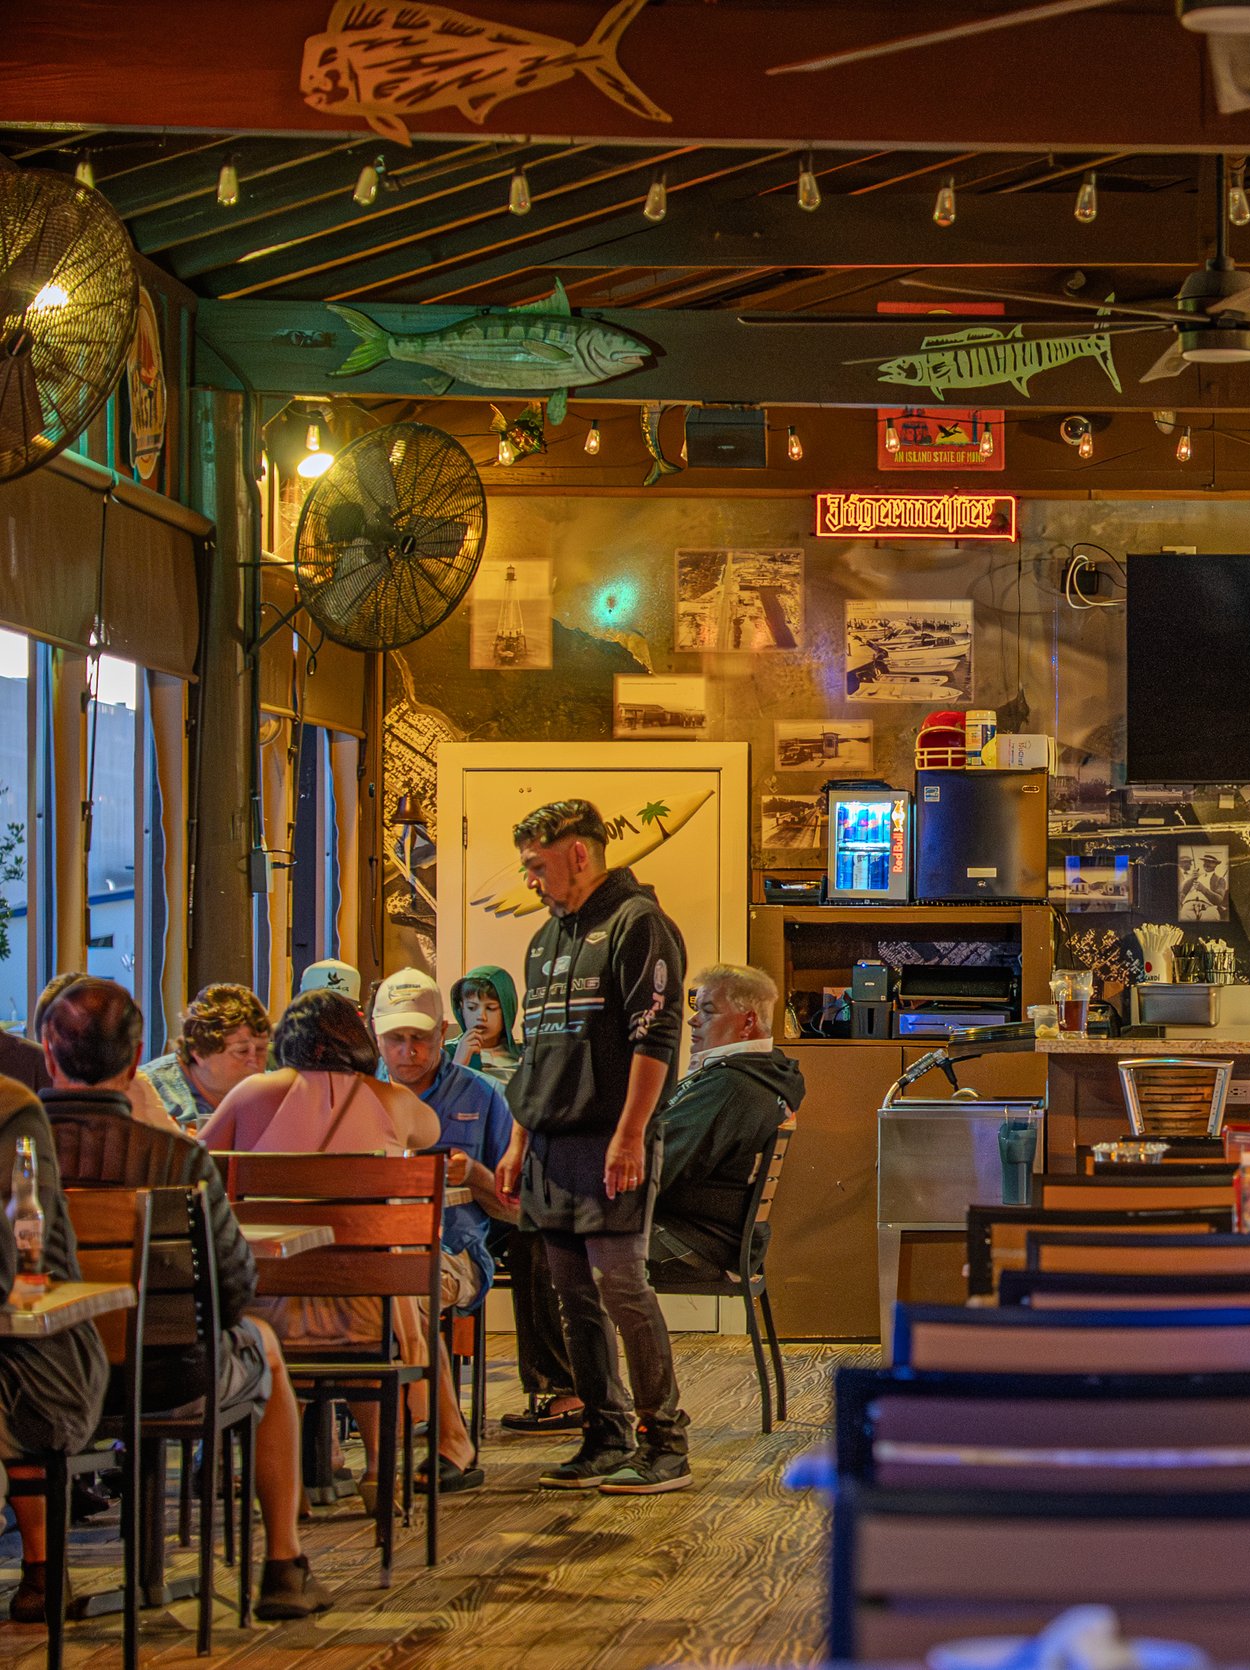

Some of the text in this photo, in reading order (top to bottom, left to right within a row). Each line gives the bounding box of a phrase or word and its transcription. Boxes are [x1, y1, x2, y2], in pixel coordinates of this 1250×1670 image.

[895, 451, 904, 463] AN
[905, 451, 932, 463] ISLAND
[933, 451, 955, 463] STATE
[956, 451, 966, 463] OF
[826, 494, 995, 532] Jägermeister
[893, 832, 904, 873] Red Bull
